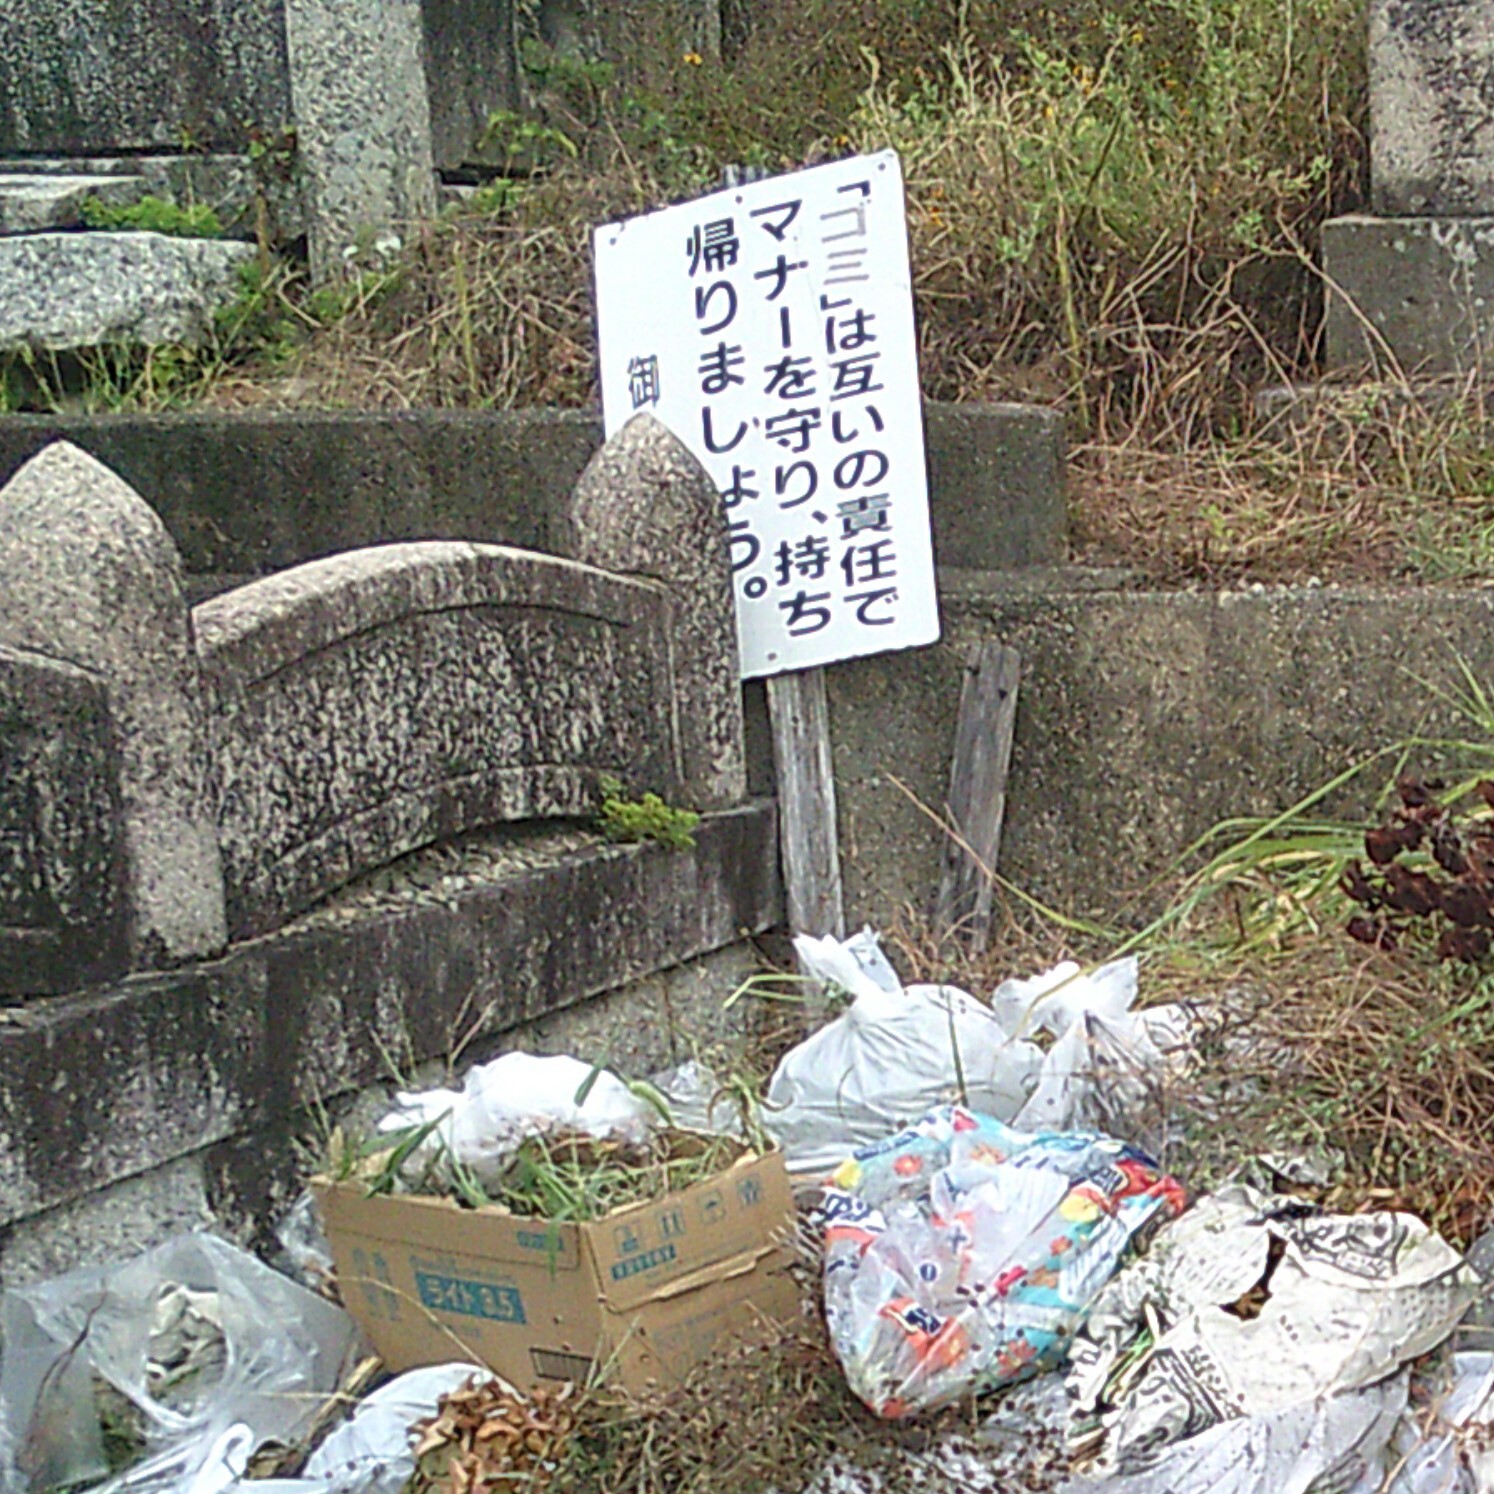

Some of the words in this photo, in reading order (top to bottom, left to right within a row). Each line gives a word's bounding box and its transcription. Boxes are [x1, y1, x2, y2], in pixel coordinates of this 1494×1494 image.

[685, 216, 769, 600] 帰りましょう。
[749, 198, 832, 638] マナーを守り、持ち
[819, 179, 900, 627] 「ゴミ」は互いの責任で
